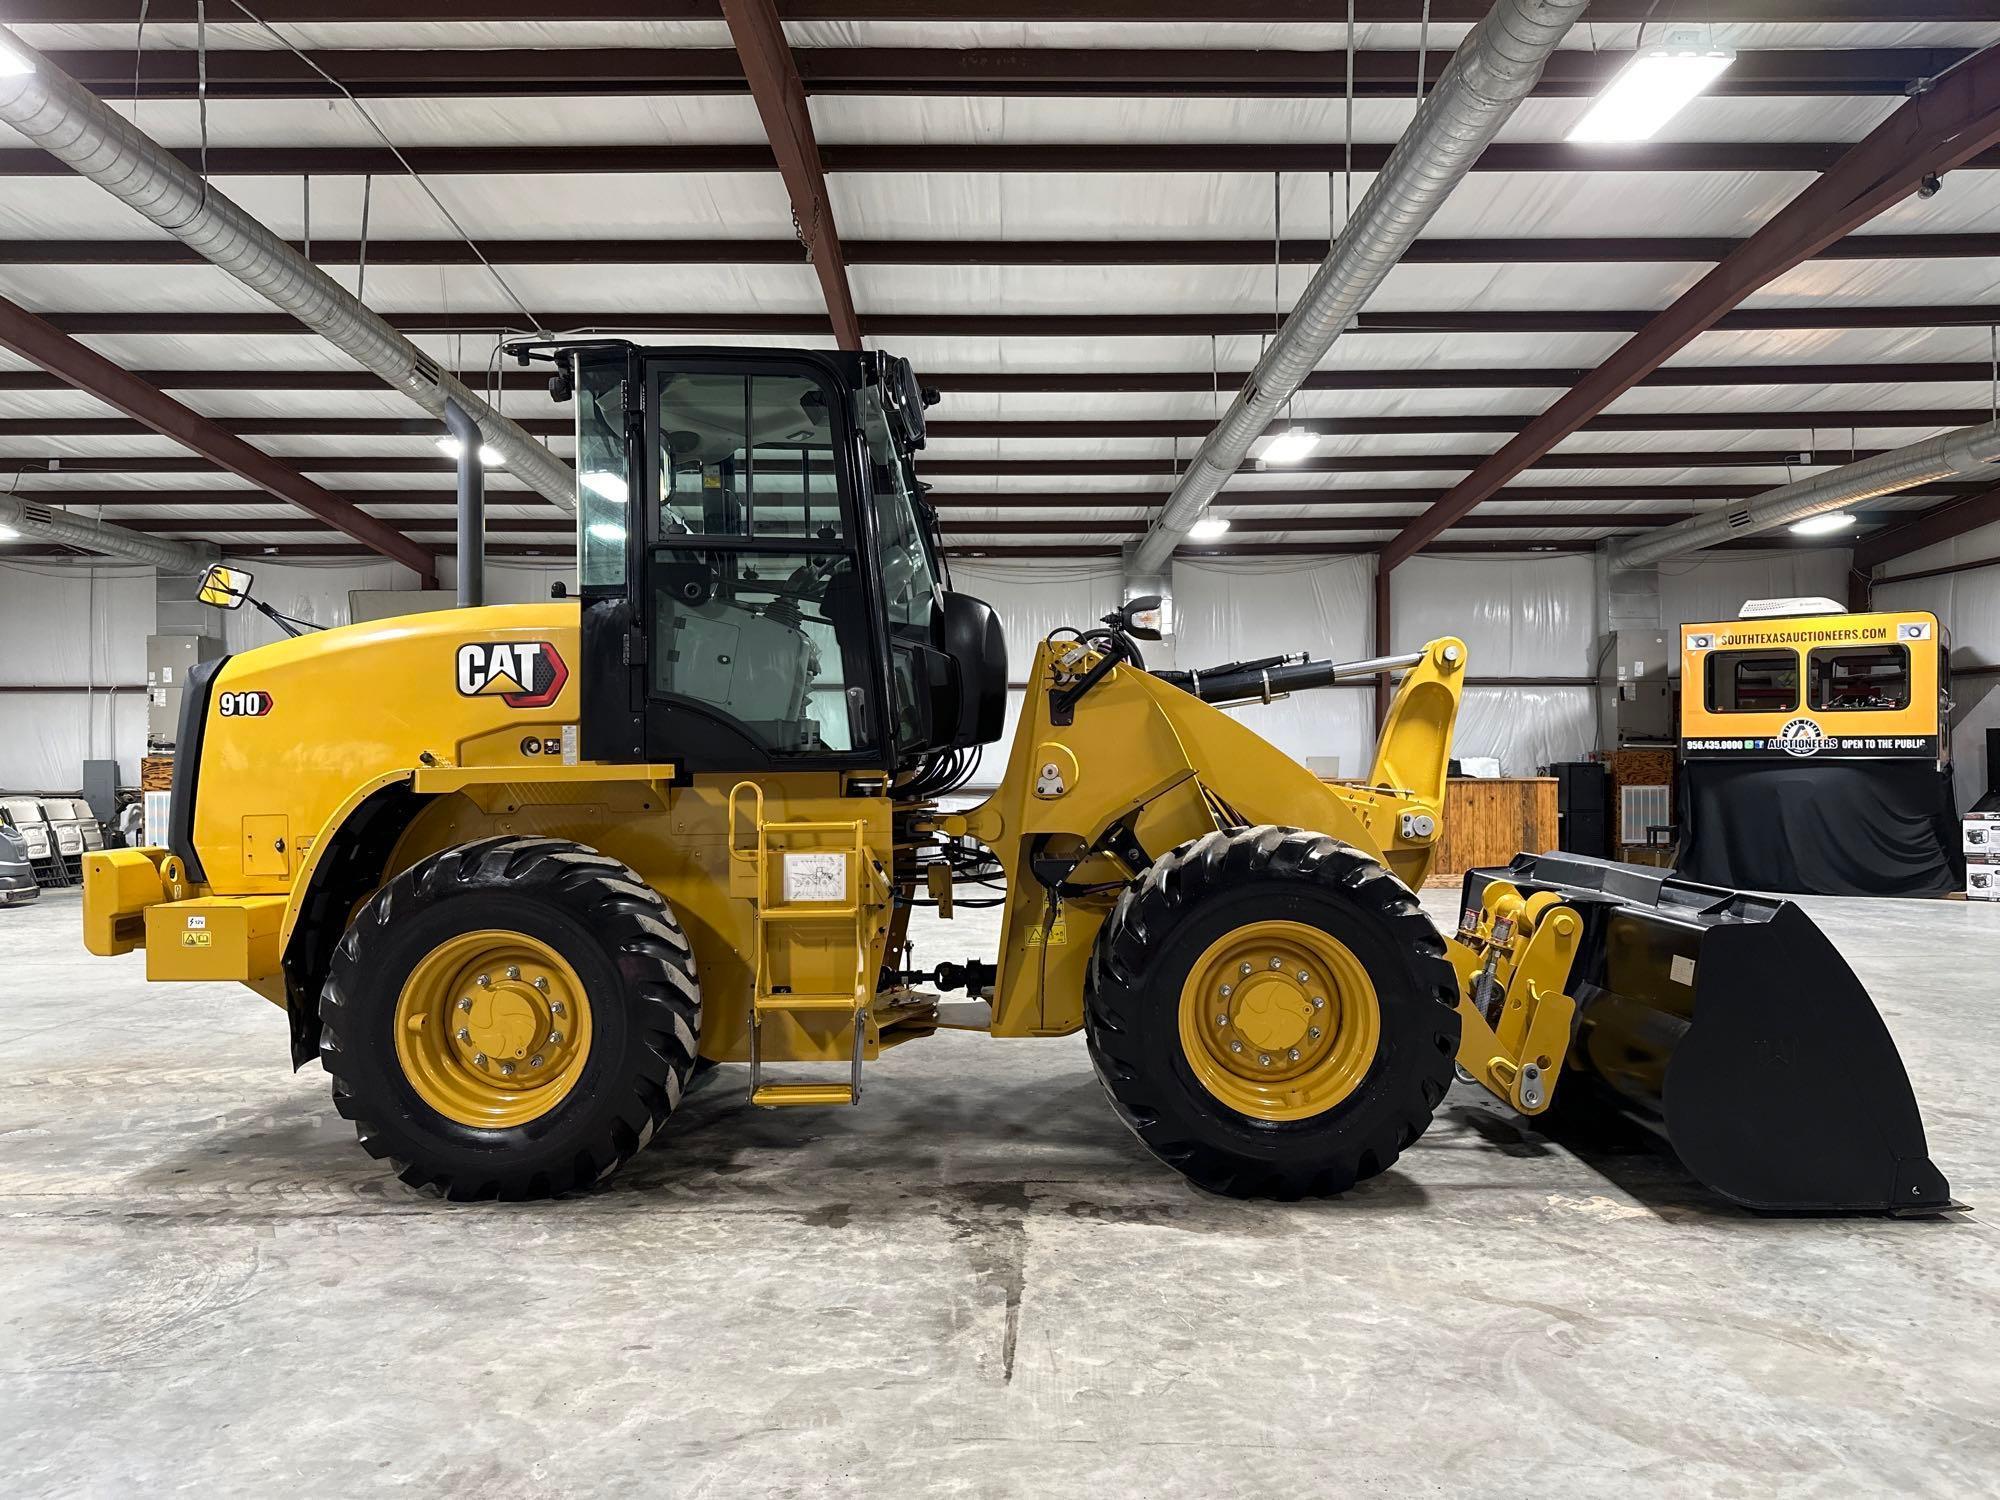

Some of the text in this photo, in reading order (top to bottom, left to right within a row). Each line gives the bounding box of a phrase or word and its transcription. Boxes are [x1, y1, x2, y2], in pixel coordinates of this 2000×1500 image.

[1721, 628, 1887, 646] SOUTHTEXASAUCTIONEERS.COM
[458, 643, 540, 694] CAT
[221, 692, 260, 716] 910
[1768, 738, 1838, 749] AUCTIONEERS
[1842, 739, 1863, 749] OPEN
[1865, 739, 1876, 749] TO
[1877, 739, 1893, 749] THE
